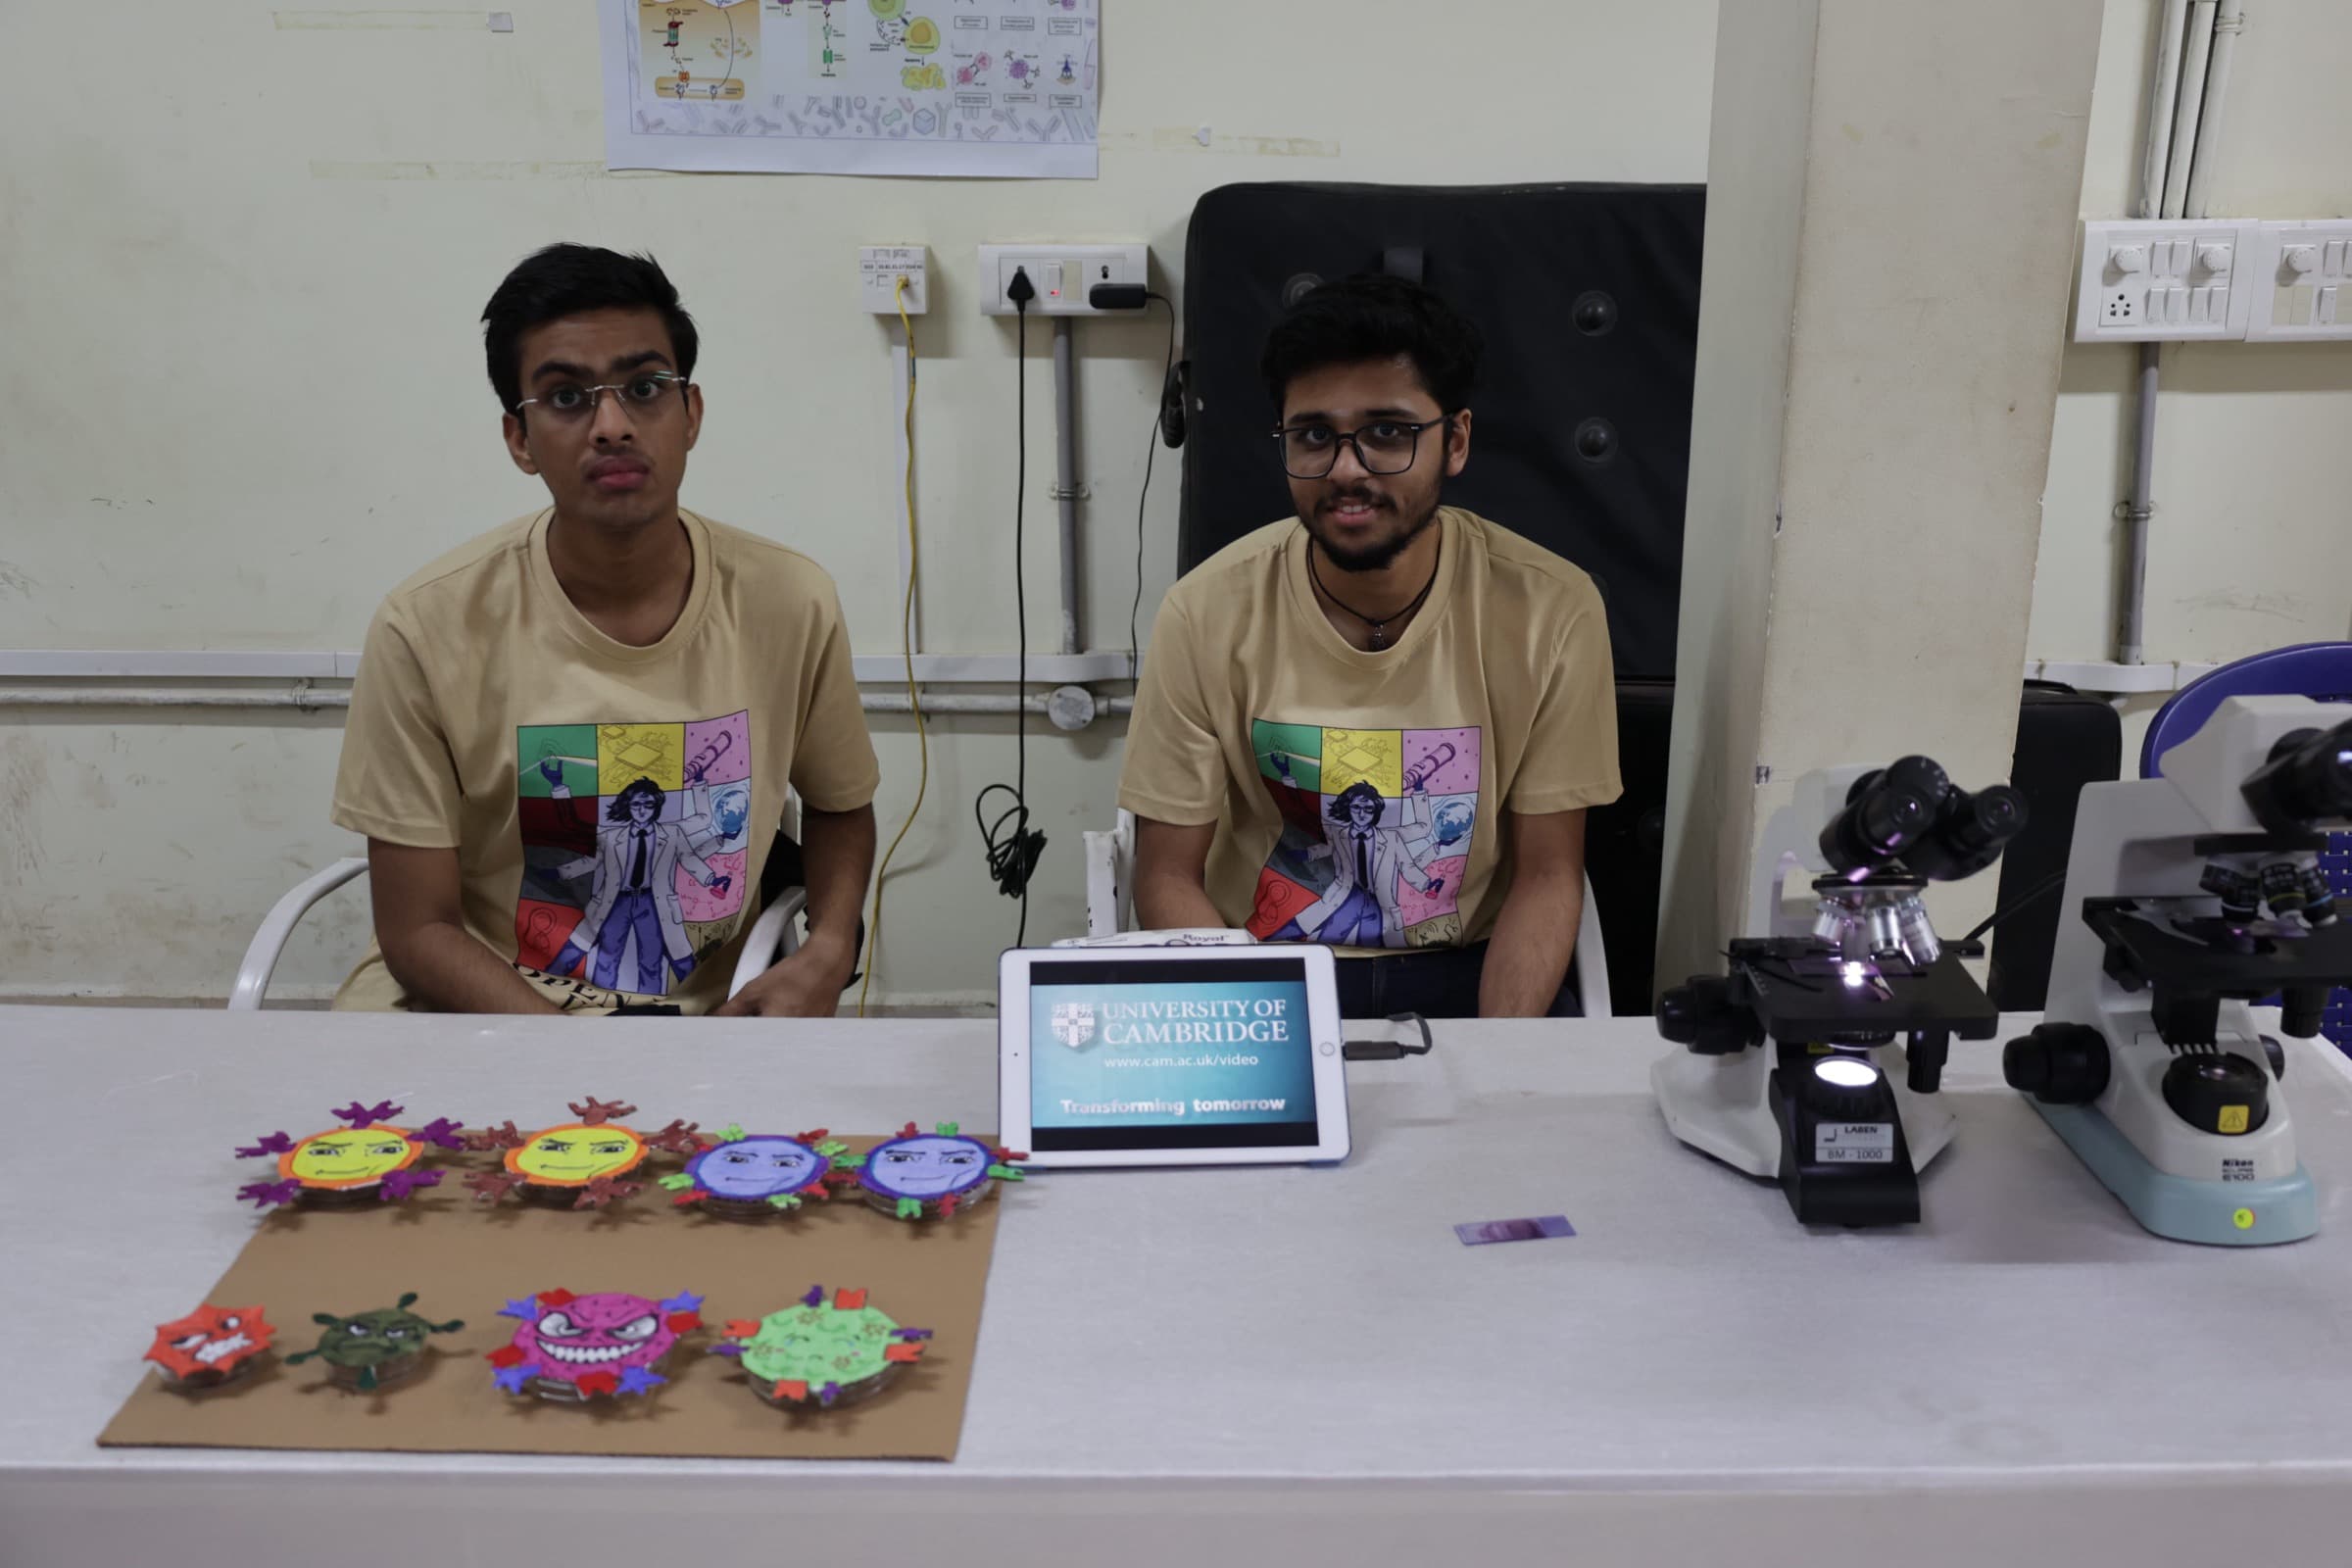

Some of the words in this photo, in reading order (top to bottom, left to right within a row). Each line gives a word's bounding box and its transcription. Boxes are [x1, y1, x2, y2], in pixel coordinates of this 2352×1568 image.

[1102, 1000, 1250, 1020] UNIVERSITY
[1253, 999, 1287, 1017] OF
[1102, 1019, 1290, 1045] CAMBRIDGE
[1103, 1054, 1259, 1068] www.cam.ac.uk/video
[1059, 1098, 1185, 1116] Transforming
[1193, 1097, 1286, 1113] tomorrow
[1857, 1150, 1883, 1159] 1000
[2222, 1158, 2254, 1167] Nikon
